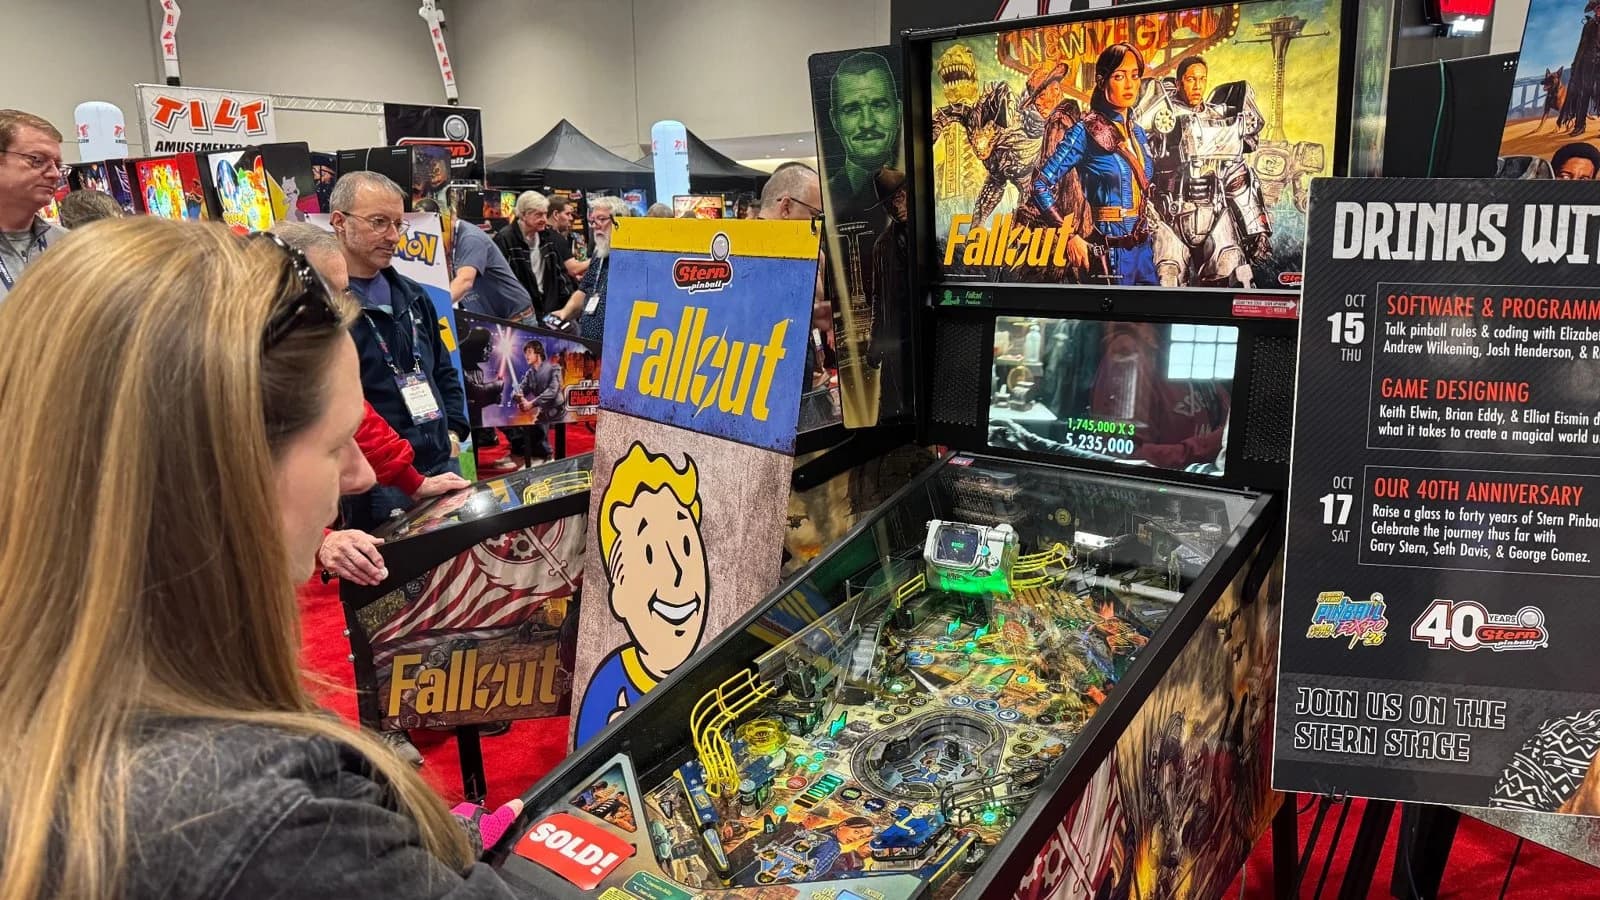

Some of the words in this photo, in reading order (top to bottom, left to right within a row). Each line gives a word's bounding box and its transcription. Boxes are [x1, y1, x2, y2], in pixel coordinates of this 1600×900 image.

[152, 95, 267, 135] TILT
[943, 213, 1075, 272] Fallout
[1332, 201, 1508, 262] DRINKS
[677, 264, 728, 283] Stern
[690, 280, 723, 292] pinball
[1345, 294, 1366, 307] OCT
[1387, 294, 1474, 318] SOFTWARE
[1481, 297, 1494, 318] &
[1327, 312, 1366, 344] 15
[1385, 322, 1406, 336] Talk
[1410, 323, 1447, 340] pinball
[1451, 324, 1477, 338] rules
[1481, 325, 1490, 338] &
[1494, 324, 1528, 342] coding
[1533, 325, 1556, 340] with
[1560, 325, 1600, 341] Elizabe
[615, 300, 789, 422] Fallout
[1341, 348, 1362, 361] THU
[1383, 341, 1422, 355] Andrew
[1427, 342, 1482, 358] Wilkening,
[1486, 341, 1510, 357] Josh
[1514, 343, 1574, 360] Henderson,
[1579, 345, 1588, 359] &
[1592, 345, 1600, 359] R
[1381, 377, 1428, 400] GAME
[1435, 379, 1530, 403] DESIGNING
[1379, 404, 1406, 419] Keith
[1410, 405, 1441, 422] Elwin,
[1445, 407, 1474, 421] Brian
[1478, 408, 1506, 425] Eddy,
[1510, 408, 1519, 423] &
[1523, 408, 1550, 424] Elliot
[1554, 410, 1589, 426] Eismin
[1067, 418, 1116, 434] 1,745,000
[1118, 423, 1126, 435] X
[1127, 424, 1135, 436] 3
[1378, 422, 1403, 437] what
[1407, 424, 1415, 437] it
[1419, 424, 1447, 438] takes
[1450, 425, 1461, 439] to
[1465, 427, 1497, 440] create
[1501, 430, 1508, 440] a
[1512, 427, 1554, 444] magical
[1558, 428, 1588, 443] world
[1592, 433, 1600, 444] u
[1065, 433, 1134, 454] 5,235,000
[1333, 476, 1354, 489] OCT
[1374, 477, 1409, 499] OUR
[1416, 479, 1460, 501] 40TH
[1465, 481, 1583, 506] ANNIVERSARY
[1319, 493, 1353, 525] 17
[1372, 504, 1400, 519] Raise
[1404, 508, 1411, 518] a
[1414, 507, 1441, 522] glass
[1444, 509, 1455, 521] to
[1459, 508, 1485, 525] forty
[1488, 512, 1518, 527] years
[1521, 510, 1534, 525] of
[1536, 511, 1564, 526] Stern
[1331, 529, 1351, 543] SAT
[1371, 521, 1420, 536] Celebrate
[1423, 523, 1440, 537] the
[1443, 525, 1484, 542] journey
[1488, 526, 1511, 540] thus
[1514, 527, 1530, 542] far
[1534, 528, 1557, 543] with
[1370, 538, 1395, 555] Gary
[1398, 540, 1428, 556] Stern,
[1433, 541, 1456, 556] Seth
[1460, 544, 1491, 560] Davis,
[1496, 544, 1505, 558] &
[1508, 545, 1547, 563] George
[1550, 547, 1591, 563] Gomez.
[1313, 598, 1384, 623] PINBALL
[1336, 618, 1387, 637] EXPO
[1412, 601, 1487, 649] 40
[1489, 613, 1517, 624] YEARS
[1482, 628, 1538, 641] Stern
[1497, 639, 1539, 649] pinball
[388, 645, 561, 717] Fallout
[1295, 687, 1358, 719] JOIN
[1365, 691, 1402, 722] US
[1409, 695, 1448, 726] ON
[1453, 698, 1507, 730] THE
[1295, 722, 1377, 755] STERN
[1384, 729, 1471, 762] STAGE
[529, 822, 619, 876] SOLD!
